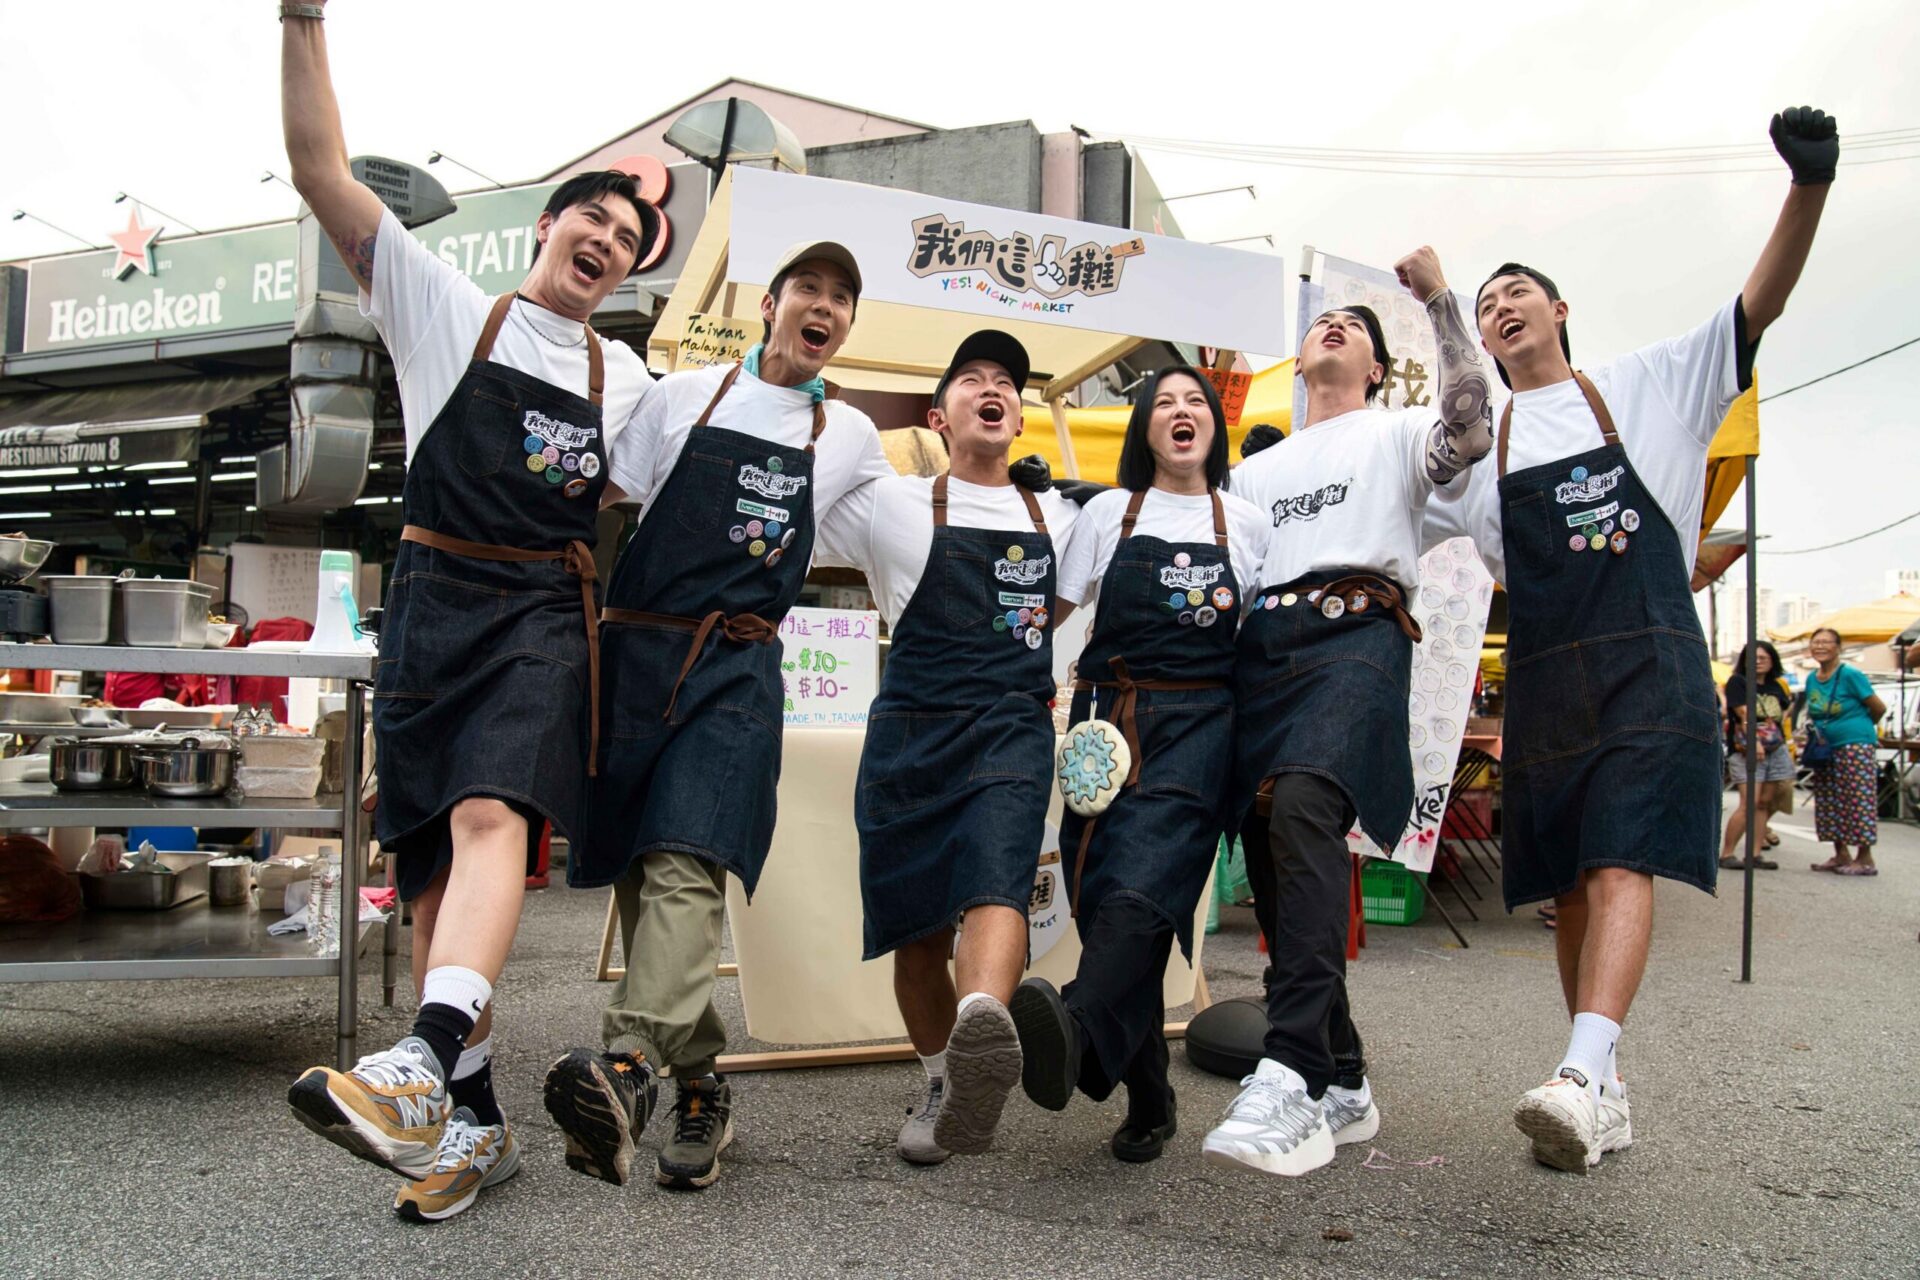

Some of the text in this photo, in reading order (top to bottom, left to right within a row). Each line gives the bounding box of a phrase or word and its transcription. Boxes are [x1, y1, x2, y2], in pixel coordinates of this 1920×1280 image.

[365, 159, 410, 177] KITCHEN
[365, 172, 409, 189] EXHAUST
[368, 184, 409, 201] UCTING
[252, 225, 535, 304] RE STATI
[941, 276, 1075, 313] YES! NIGHT MARKET
[48, 288, 222, 342] Heineken
[688, 314, 746, 340] Taiwan
[680, 338, 745, 358] Malaysia
[0, 436, 120, 466] RESTORAN STATION 8
[783, 713, 809, 724] MADE
[815, 712, 826, 722] IN
[1408, 782, 1449, 831] KeT
